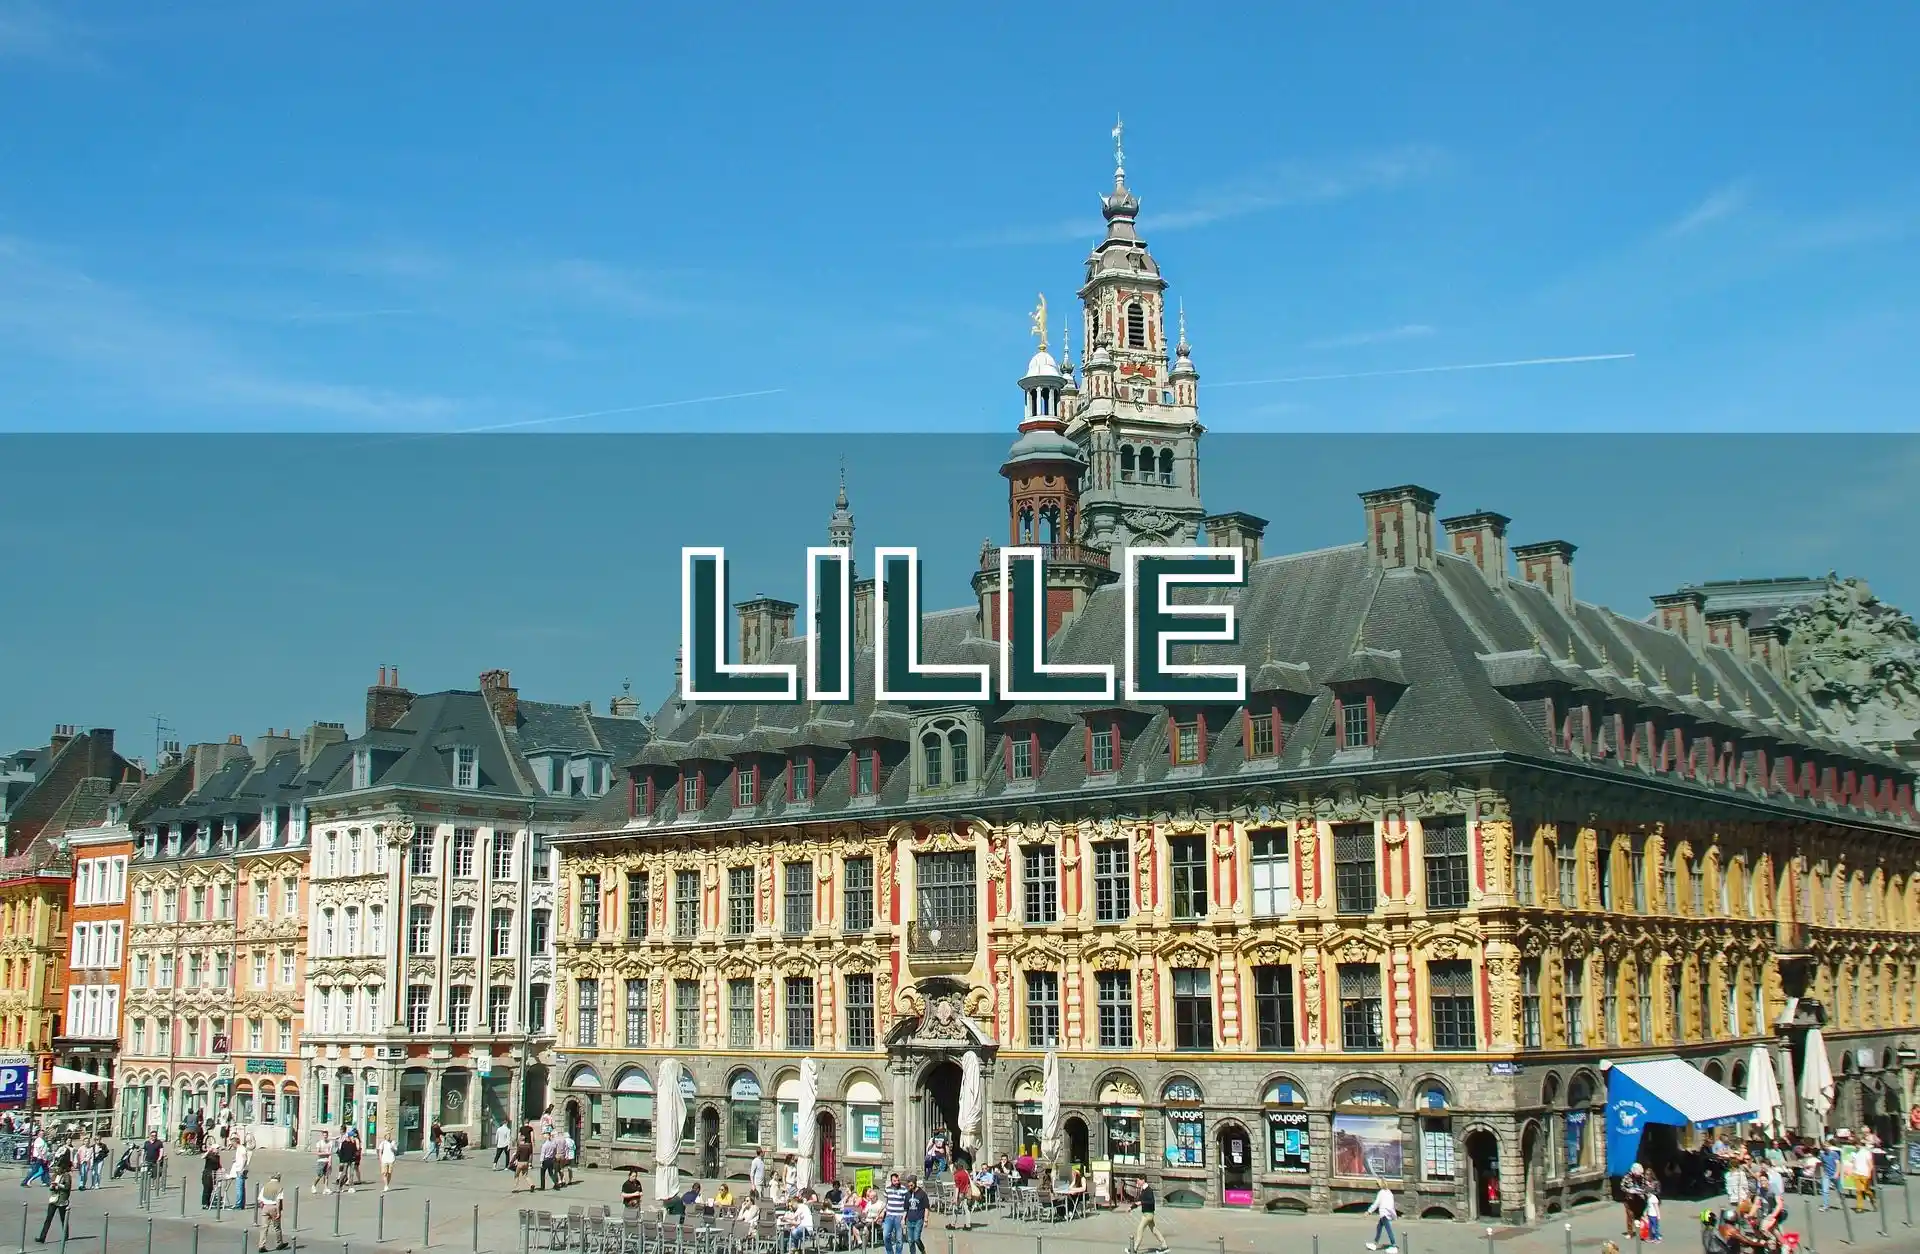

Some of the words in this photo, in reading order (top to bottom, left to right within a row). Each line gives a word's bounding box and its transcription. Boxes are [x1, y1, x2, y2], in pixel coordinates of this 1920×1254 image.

[0, 1069, 18, 1091] P
[1168, 1110, 1204, 1122] voyages
[1269, 1113, 1308, 1125] voyages
